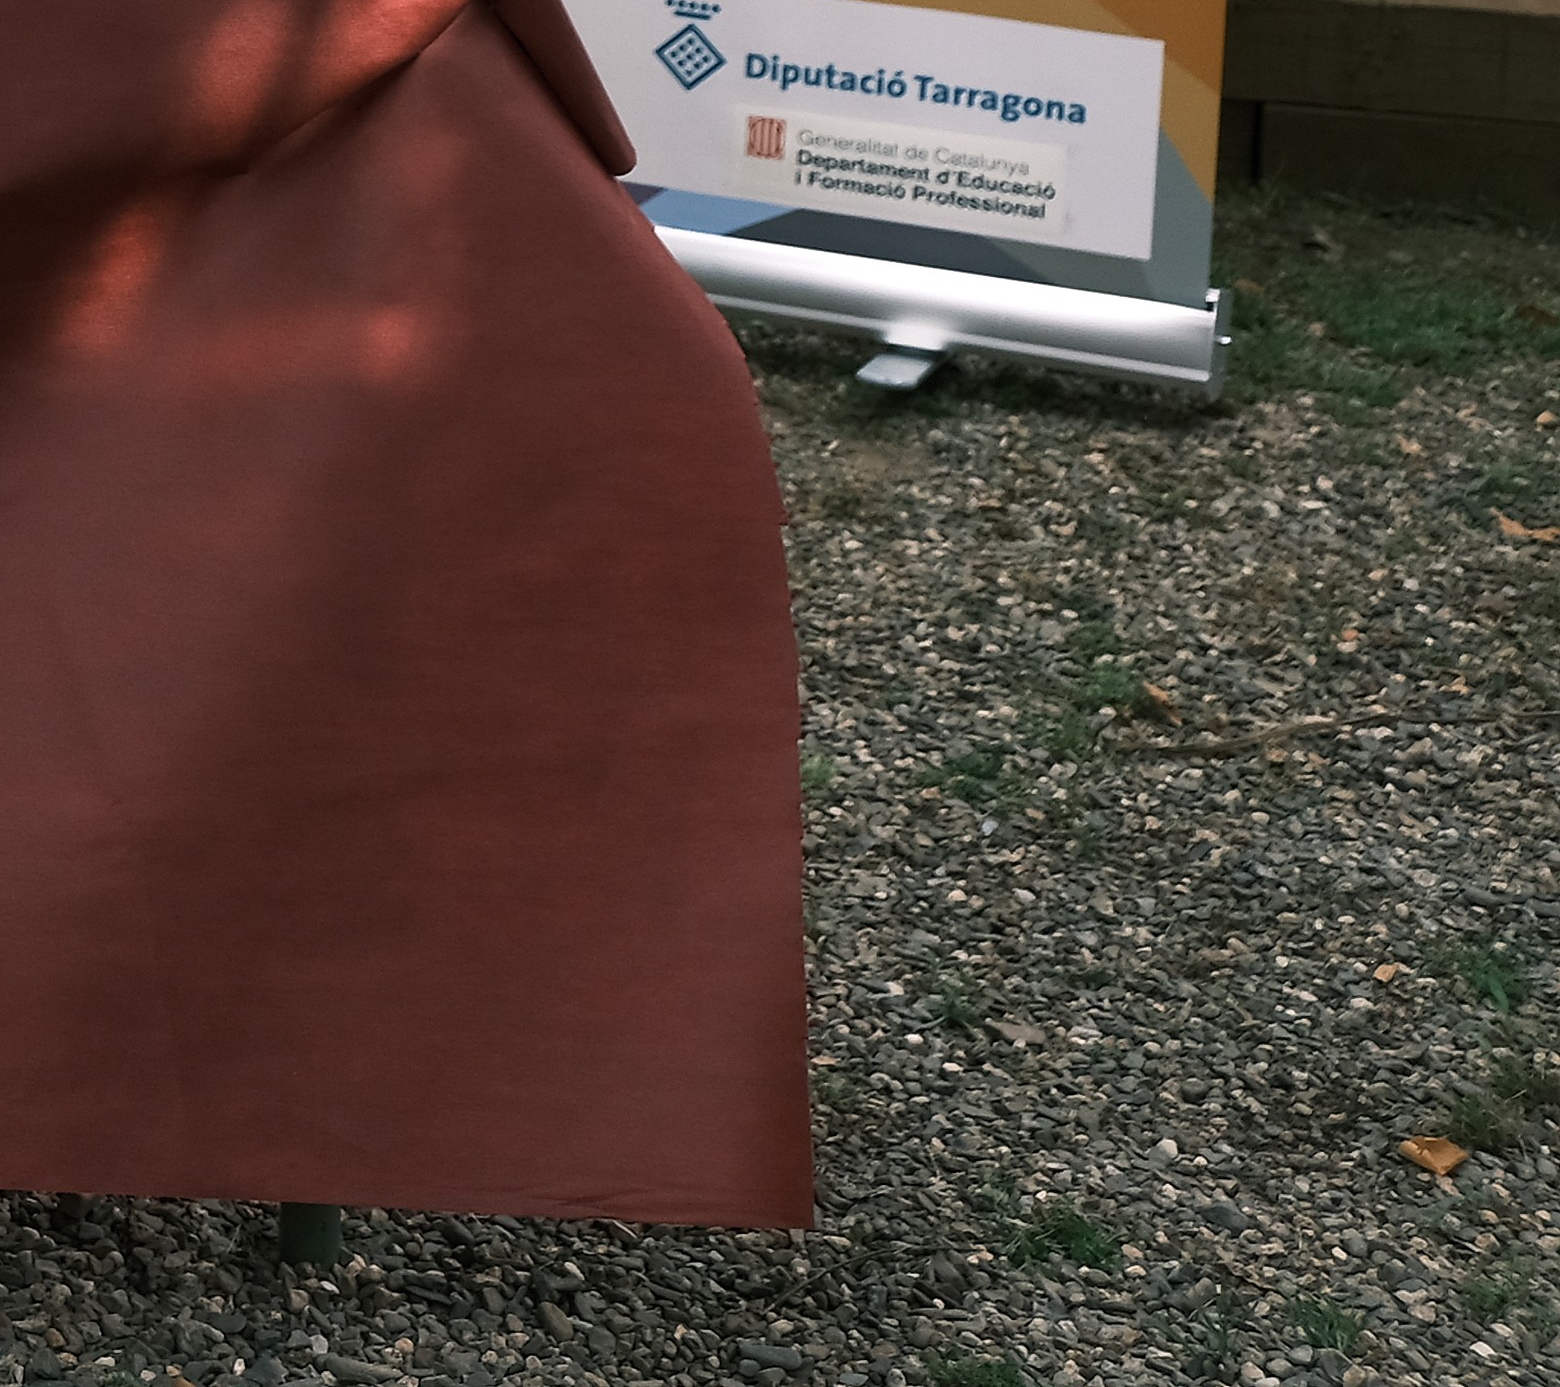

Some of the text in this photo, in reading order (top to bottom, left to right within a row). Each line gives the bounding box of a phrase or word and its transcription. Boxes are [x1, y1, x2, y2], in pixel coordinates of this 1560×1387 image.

[745, 52, 1088, 126] Diputació Tarragona
[797, 148, 930, 182] Departament
[798, 129, 1030, 177] Generalitat de Catalunya
[808, 171, 907, 200] Formació
[911, 186, 1047, 220] Professional
